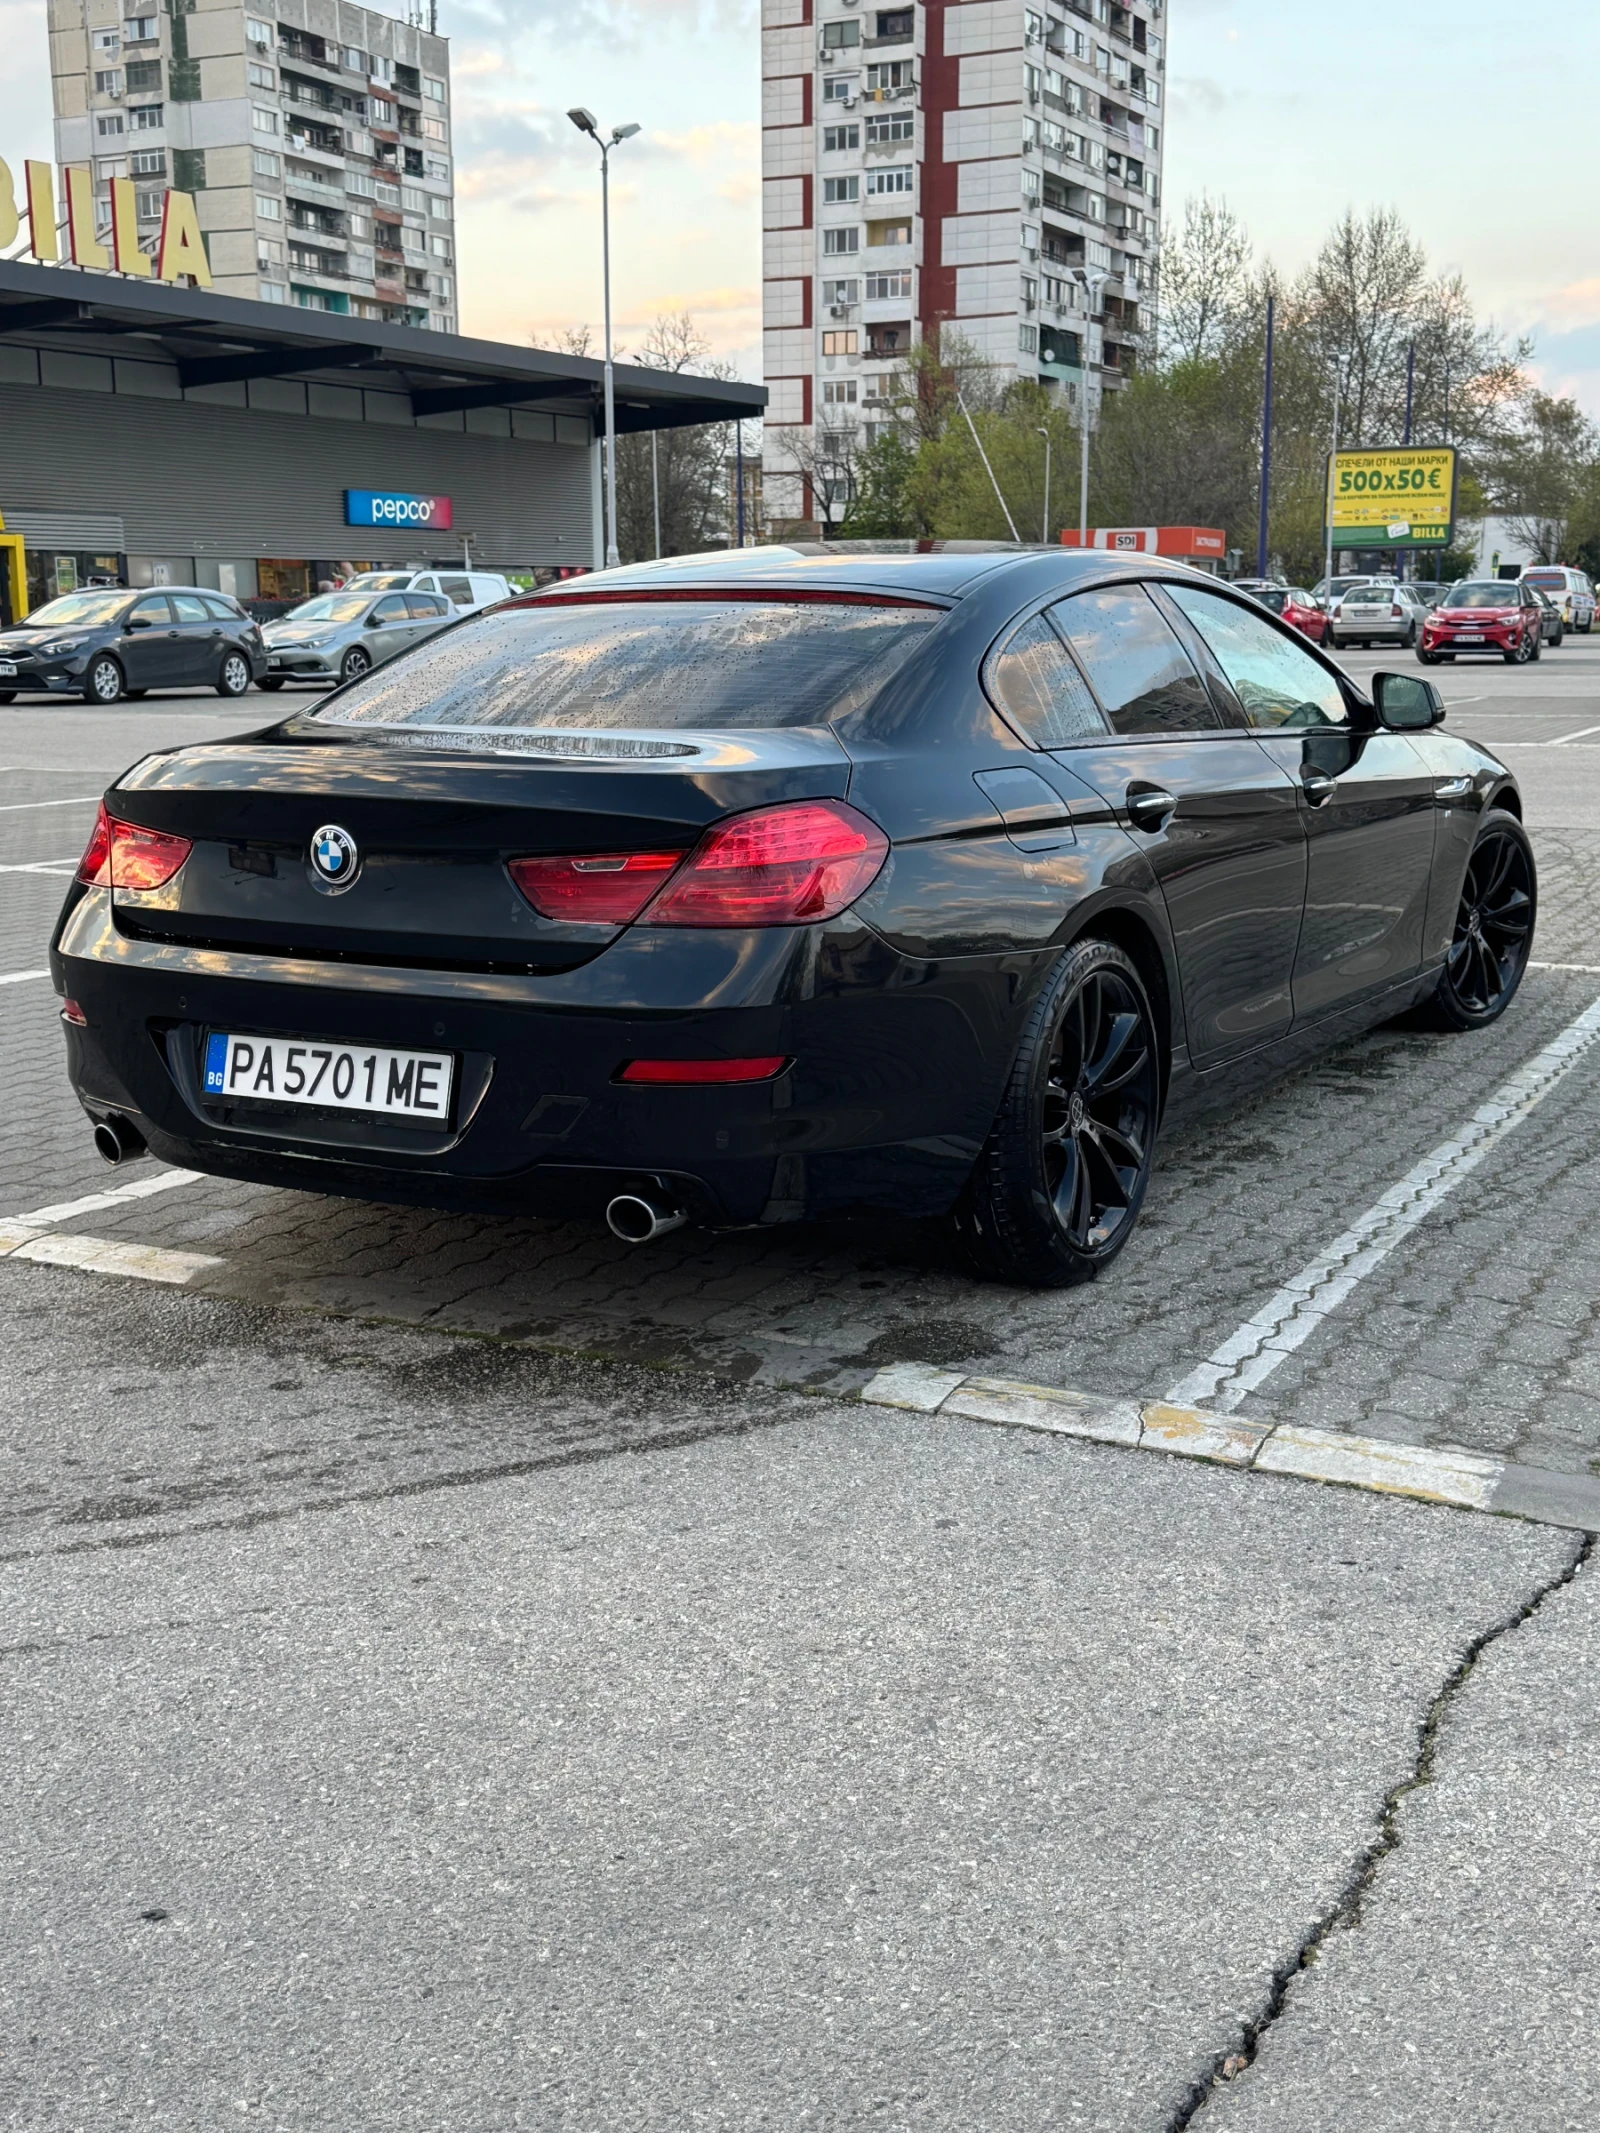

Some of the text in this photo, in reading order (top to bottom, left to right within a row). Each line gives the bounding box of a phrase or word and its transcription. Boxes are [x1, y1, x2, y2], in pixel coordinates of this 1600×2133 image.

[1335, 455, 1448, 469] СПЕЧЕЛИ ОТ НАШИ МАРКИ
[1412, 527, 1445, 538] BILLA
[1117, 536, 1135, 546] SDI
[315, 831, 347, 848] BMW
[207, 1071, 223, 1086] BG
